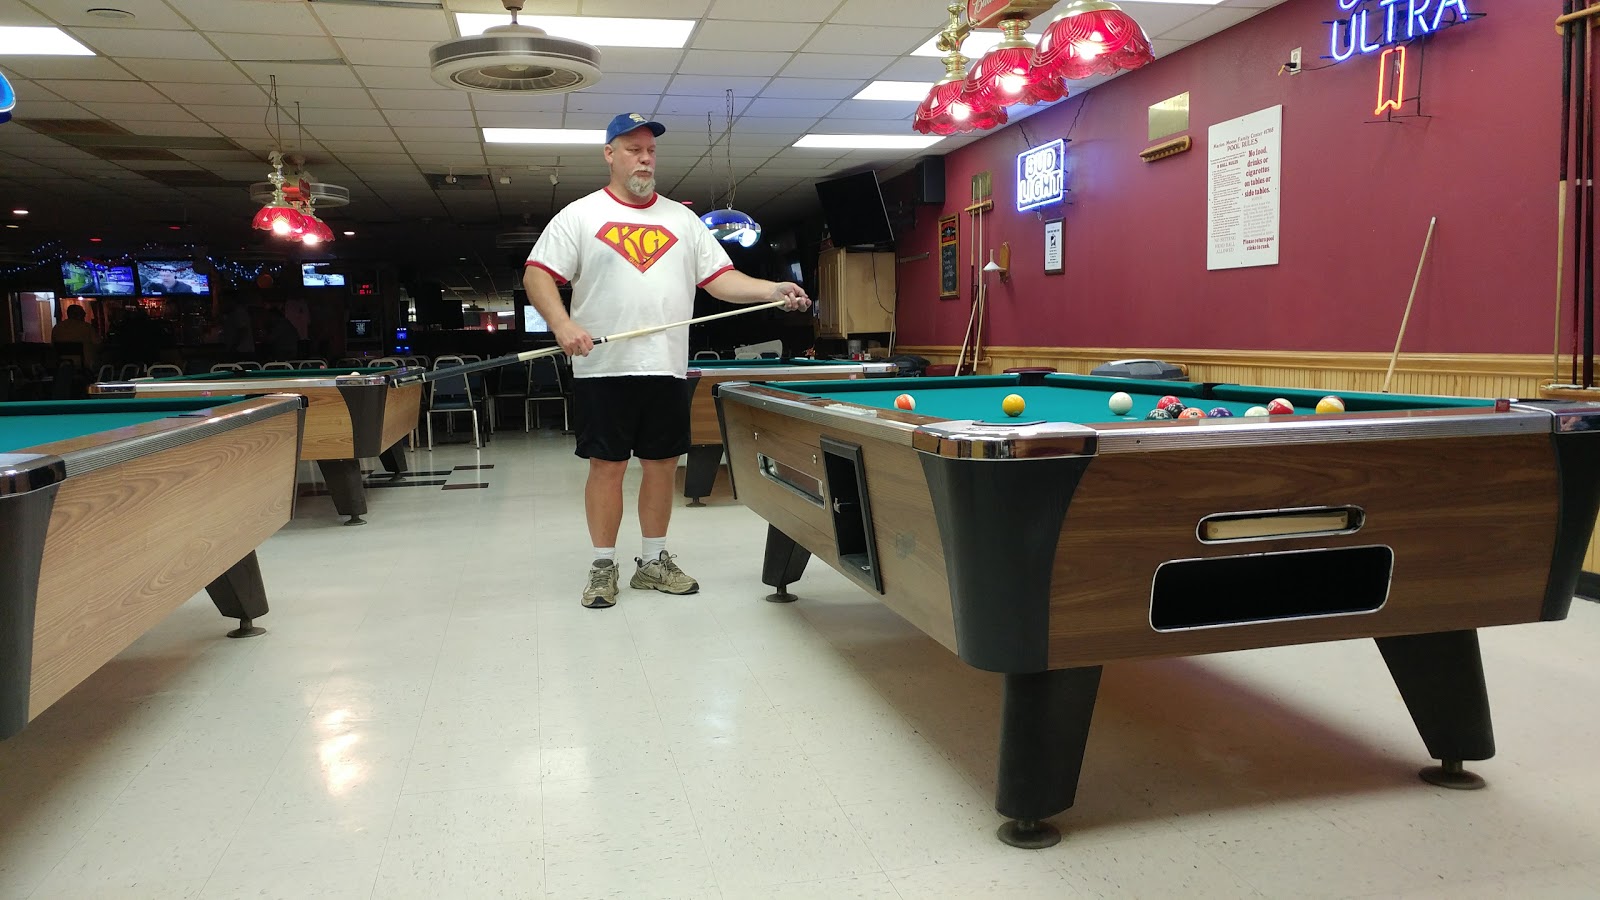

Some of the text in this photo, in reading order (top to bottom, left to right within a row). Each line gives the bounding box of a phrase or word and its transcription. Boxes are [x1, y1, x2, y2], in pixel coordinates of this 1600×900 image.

[1332, 0, 1468, 60] ULTRA
[1227, 138, 1258, 151] POOL RULES
[1248, 149, 1255, 157] No
[1025, 147, 1056, 179] BUD
[1247, 158, 1262, 167] drinks
[1245, 166, 1270, 177] cigarettes
[1020, 169, 1061, 203] LIGHT
[1250, 177, 1265, 186] tables
[1244, 189, 1254, 197] side
